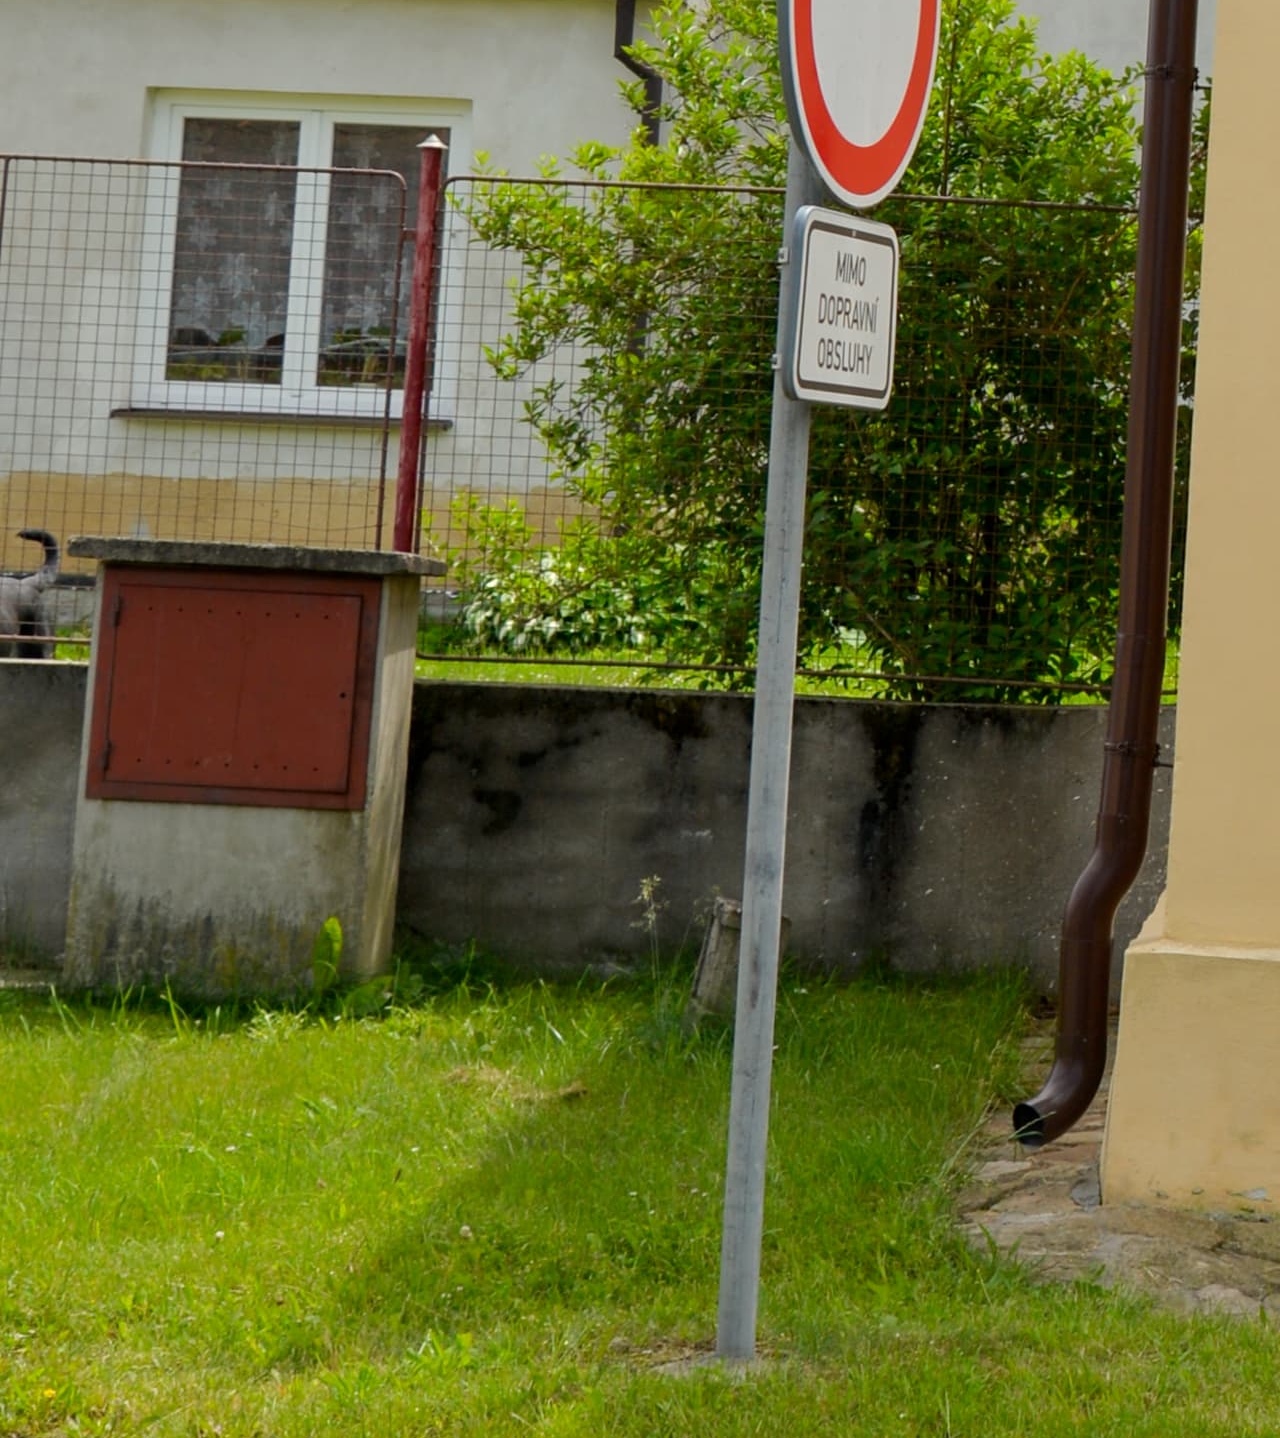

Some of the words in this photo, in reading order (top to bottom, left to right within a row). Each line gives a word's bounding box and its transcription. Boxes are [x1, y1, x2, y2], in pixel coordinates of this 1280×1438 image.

[835, 250, 866, 287] MIMO
[818, 293, 879, 333] DOPRAVNÍ
[817, 337, 873, 375] OBSLUHY
